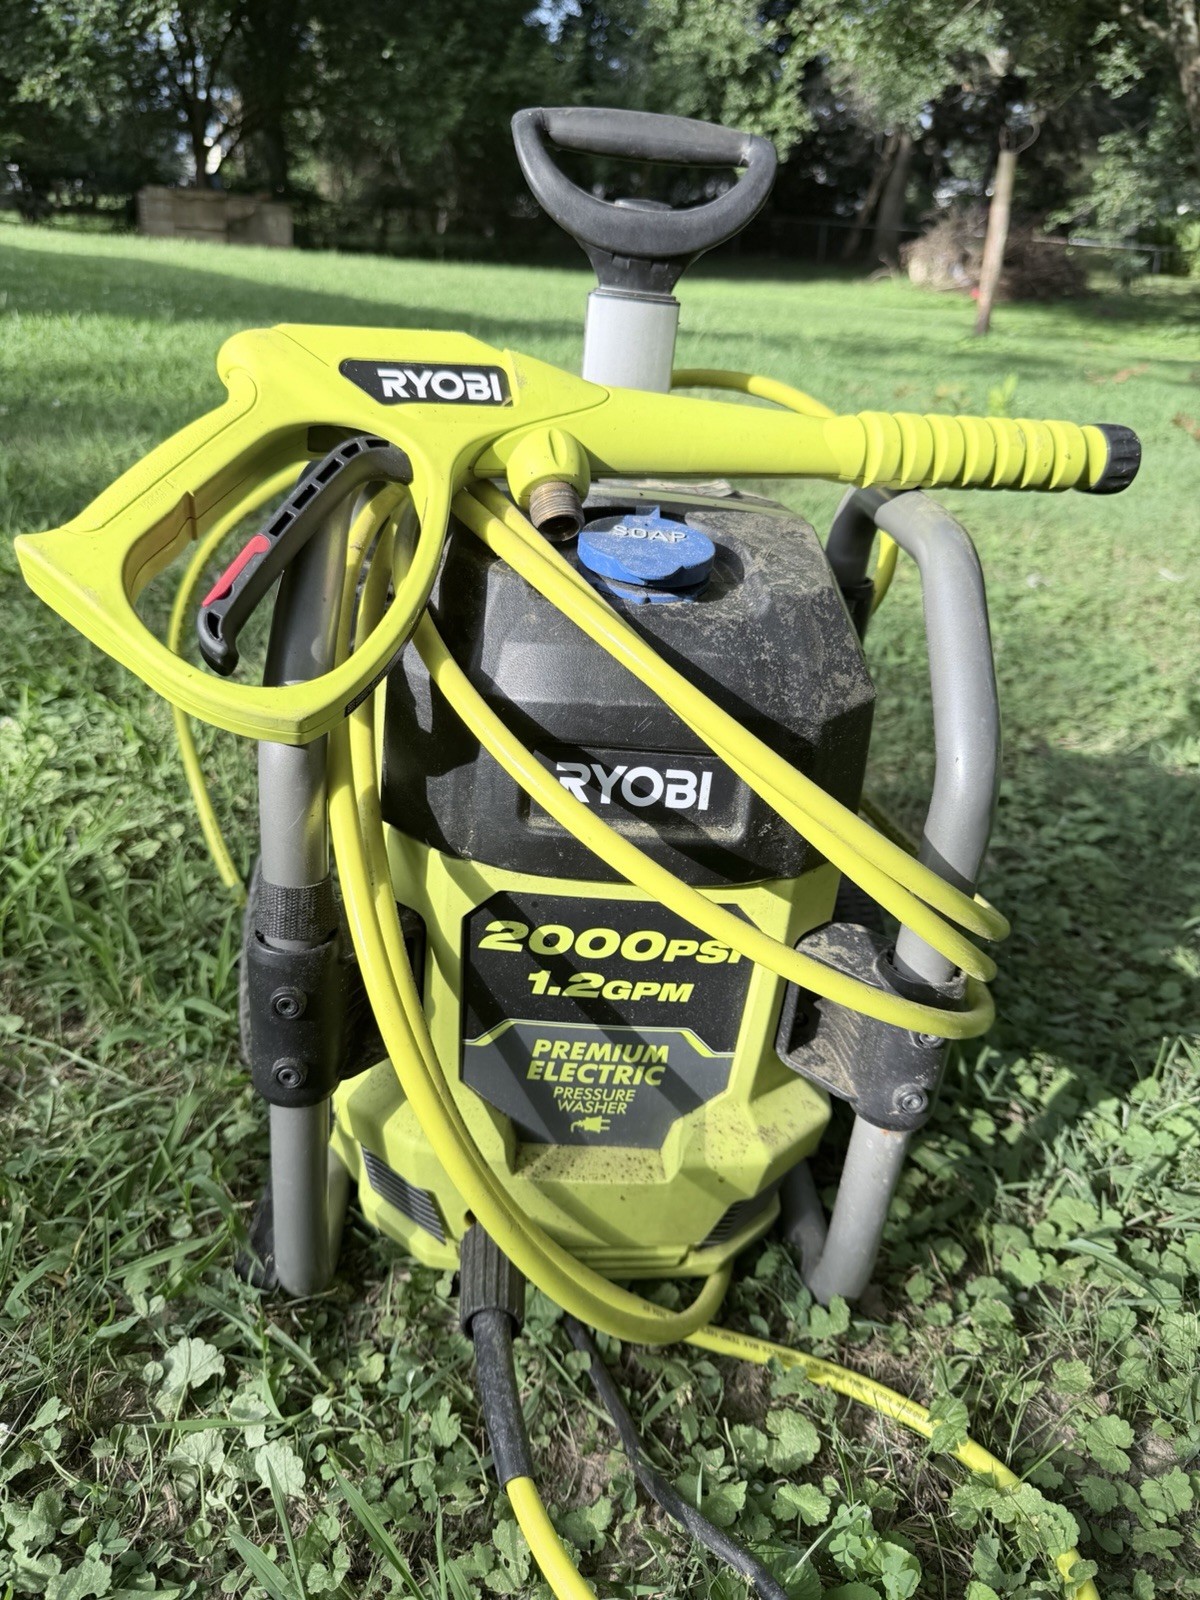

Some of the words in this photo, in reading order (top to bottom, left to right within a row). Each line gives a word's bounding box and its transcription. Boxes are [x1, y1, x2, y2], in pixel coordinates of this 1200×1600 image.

[377, 368, 503, 401] RYOBI
[613, 525, 687, 543] SOAP
[556, 762, 713, 810] RYOBI
[527, 970, 695, 1002] 1.2GPM
[532, 1039, 669, 1063] PREMIUM
[526, 1061, 665, 1085] ELECTRIC
[553, 1086, 636, 1102] PRESSURE
[557, 1099, 627, 1115] WASHER
